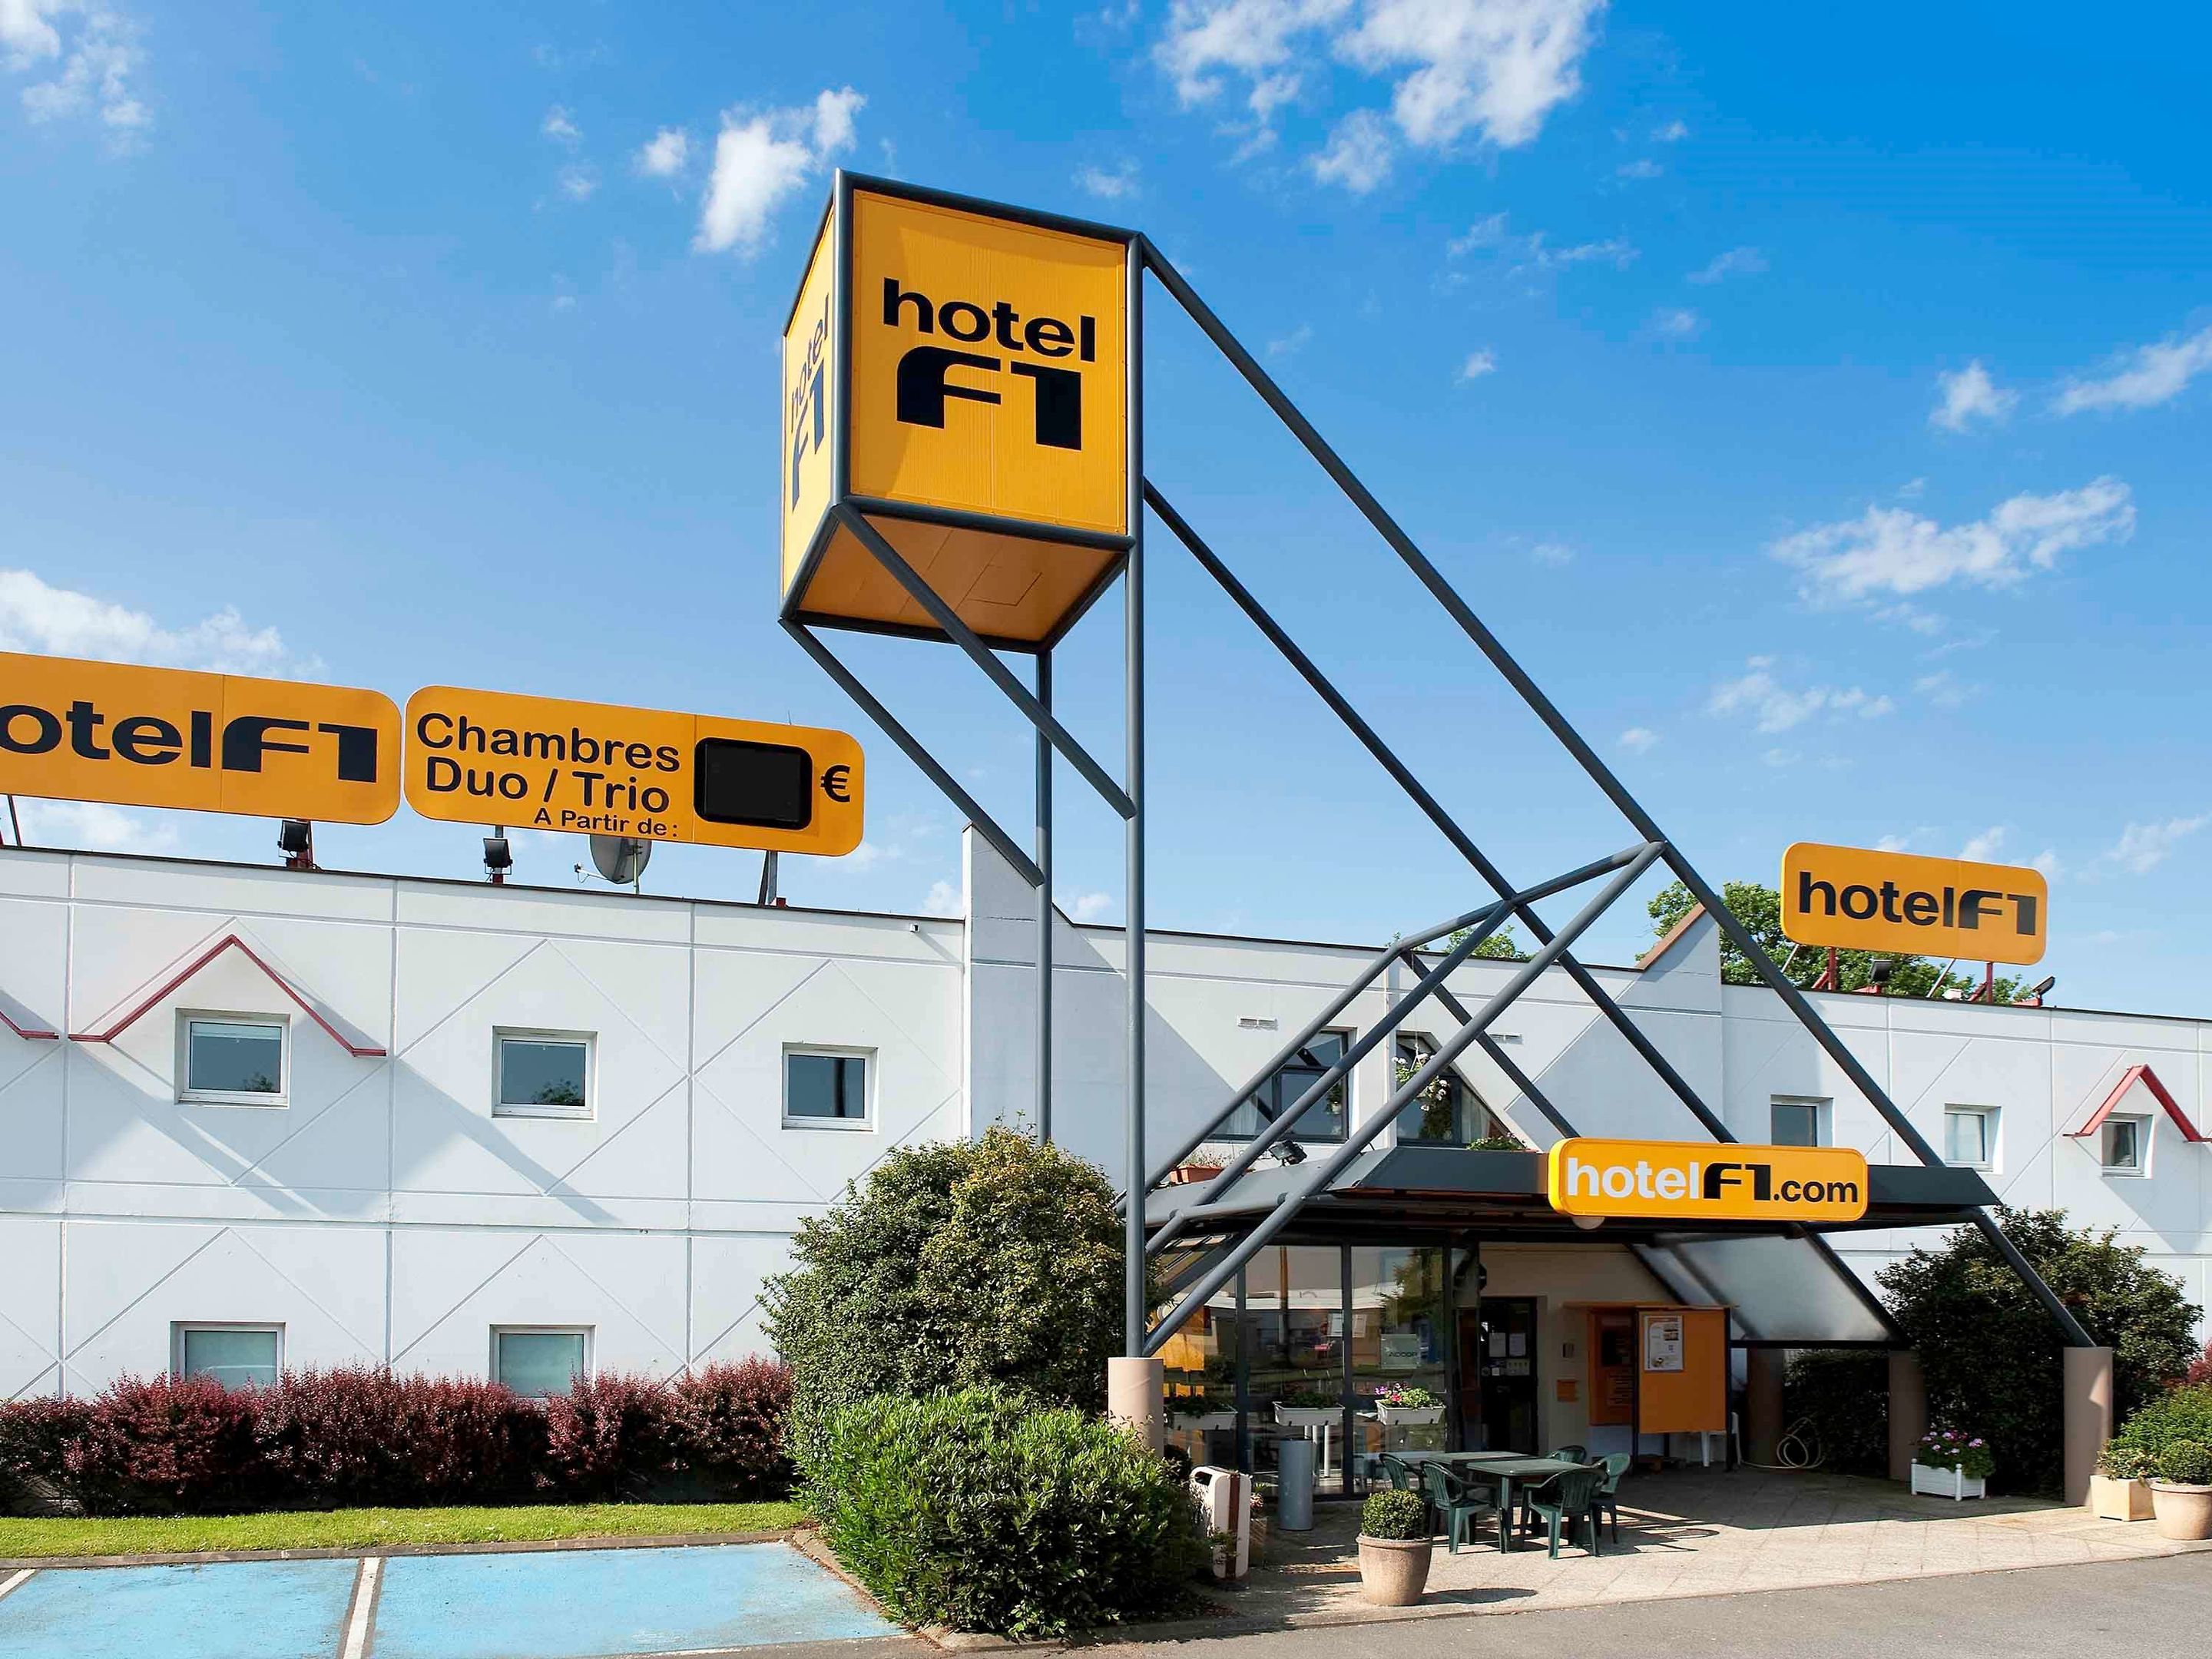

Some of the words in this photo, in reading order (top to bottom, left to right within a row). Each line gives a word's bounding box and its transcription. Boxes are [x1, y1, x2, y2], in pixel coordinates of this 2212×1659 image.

[882, 276, 1096, 363] hotel
[896, 346, 1082, 452] F1
[791, 357, 825, 514] F1
[417, 712, 680, 773] Chambres
[426, 756, 528, 800] Duo
[571, 770, 670, 813] Trio
[820, 764, 851, 803] €
[533, 807, 552, 825] A
[561, 810, 630, 833] Partir
[1799, 871, 2037, 935] hotelF1
[1567, 1157, 1858, 1204] hotelF1.com
